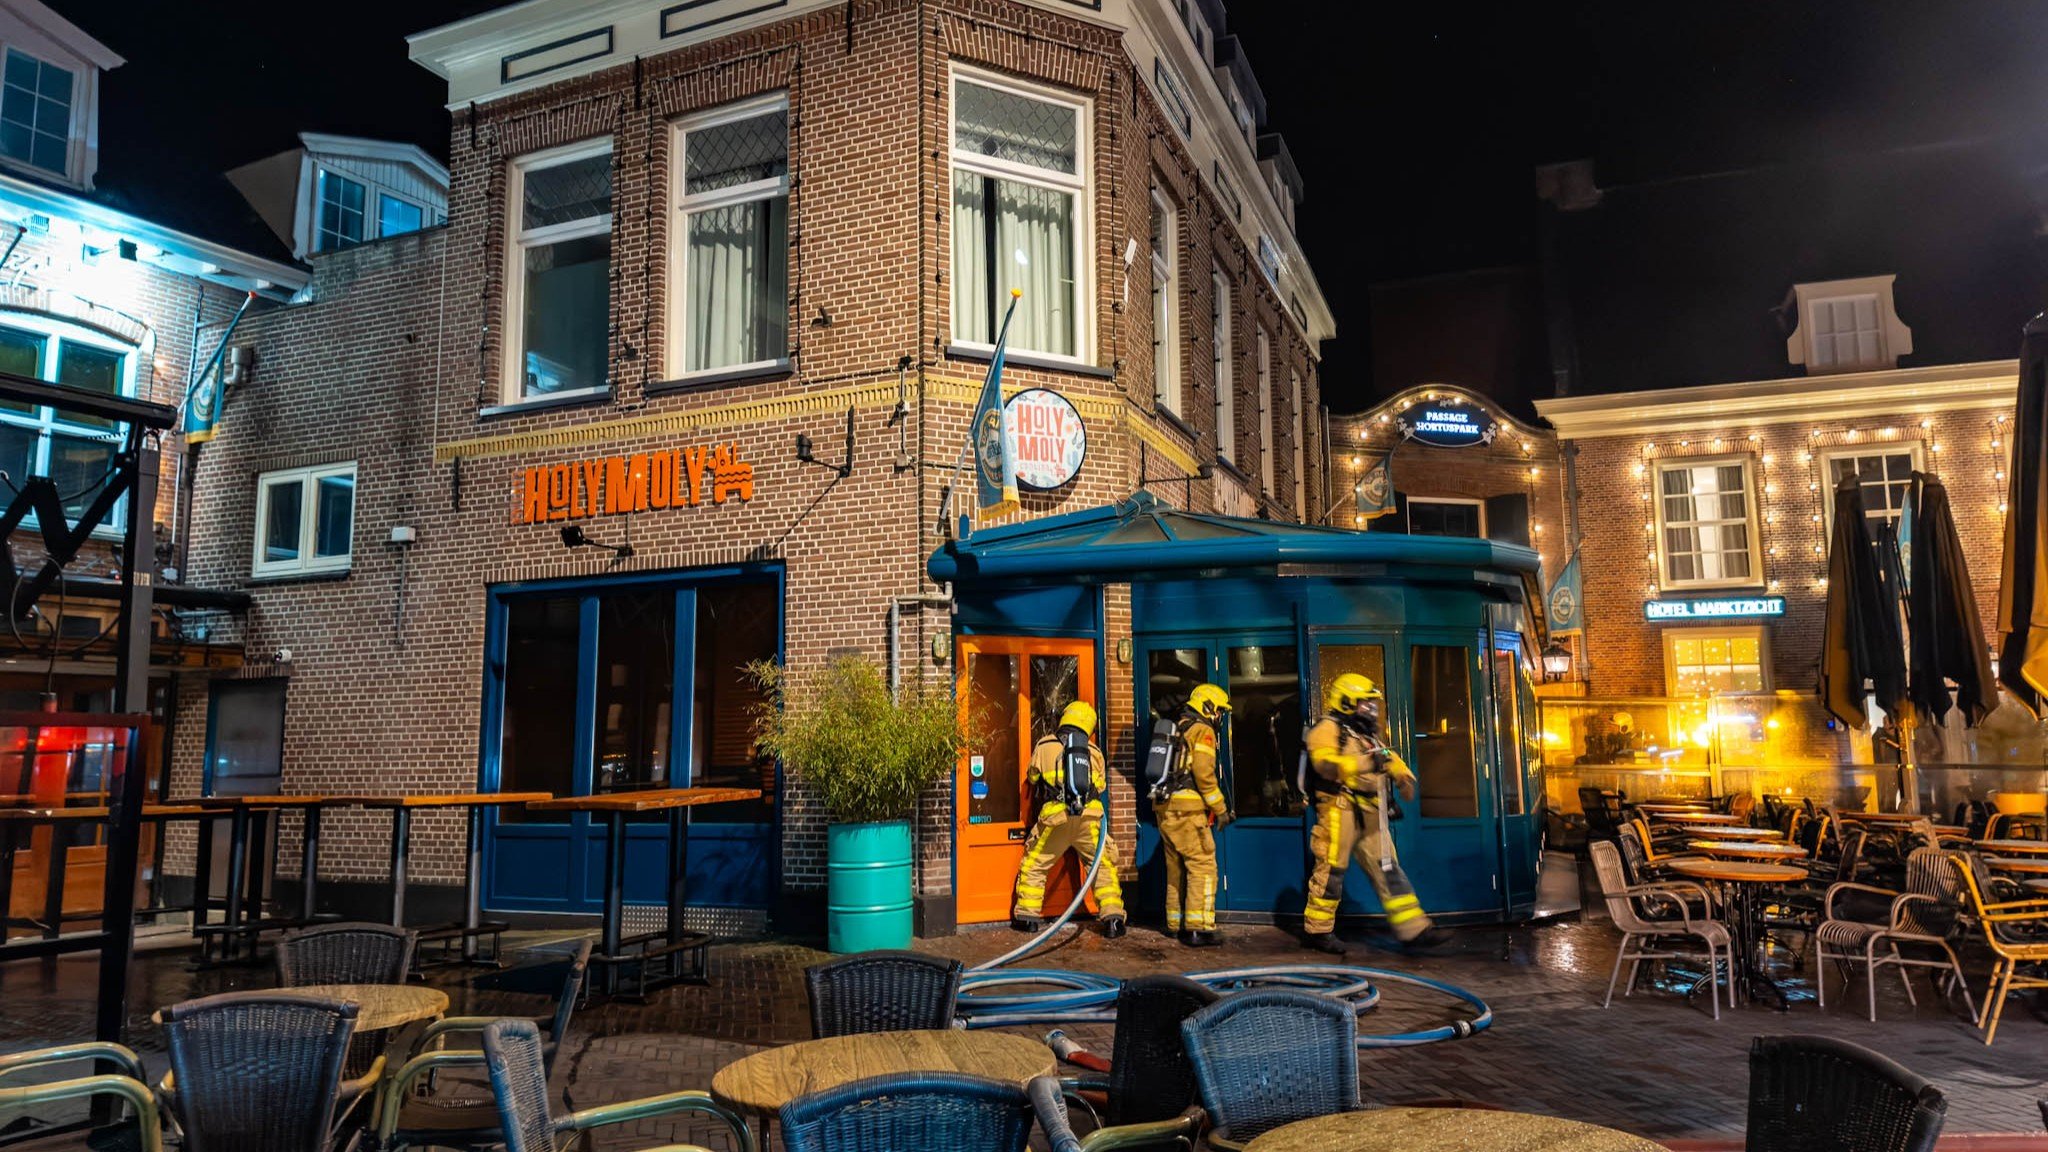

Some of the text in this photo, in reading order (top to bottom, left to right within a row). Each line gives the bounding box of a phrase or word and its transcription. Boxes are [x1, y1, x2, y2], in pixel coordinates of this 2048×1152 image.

[1017, 403, 1065, 437] HOLY
[1426, 412, 1468, 422] PASSAGE
[1416, 422, 1479, 434] HORTUSPARK
[1017, 435, 1065, 464] MOLY
[1647, 600, 1783, 617] HOTEL MARKTZICHT
[1075, 757, 1090, 768] VNO
